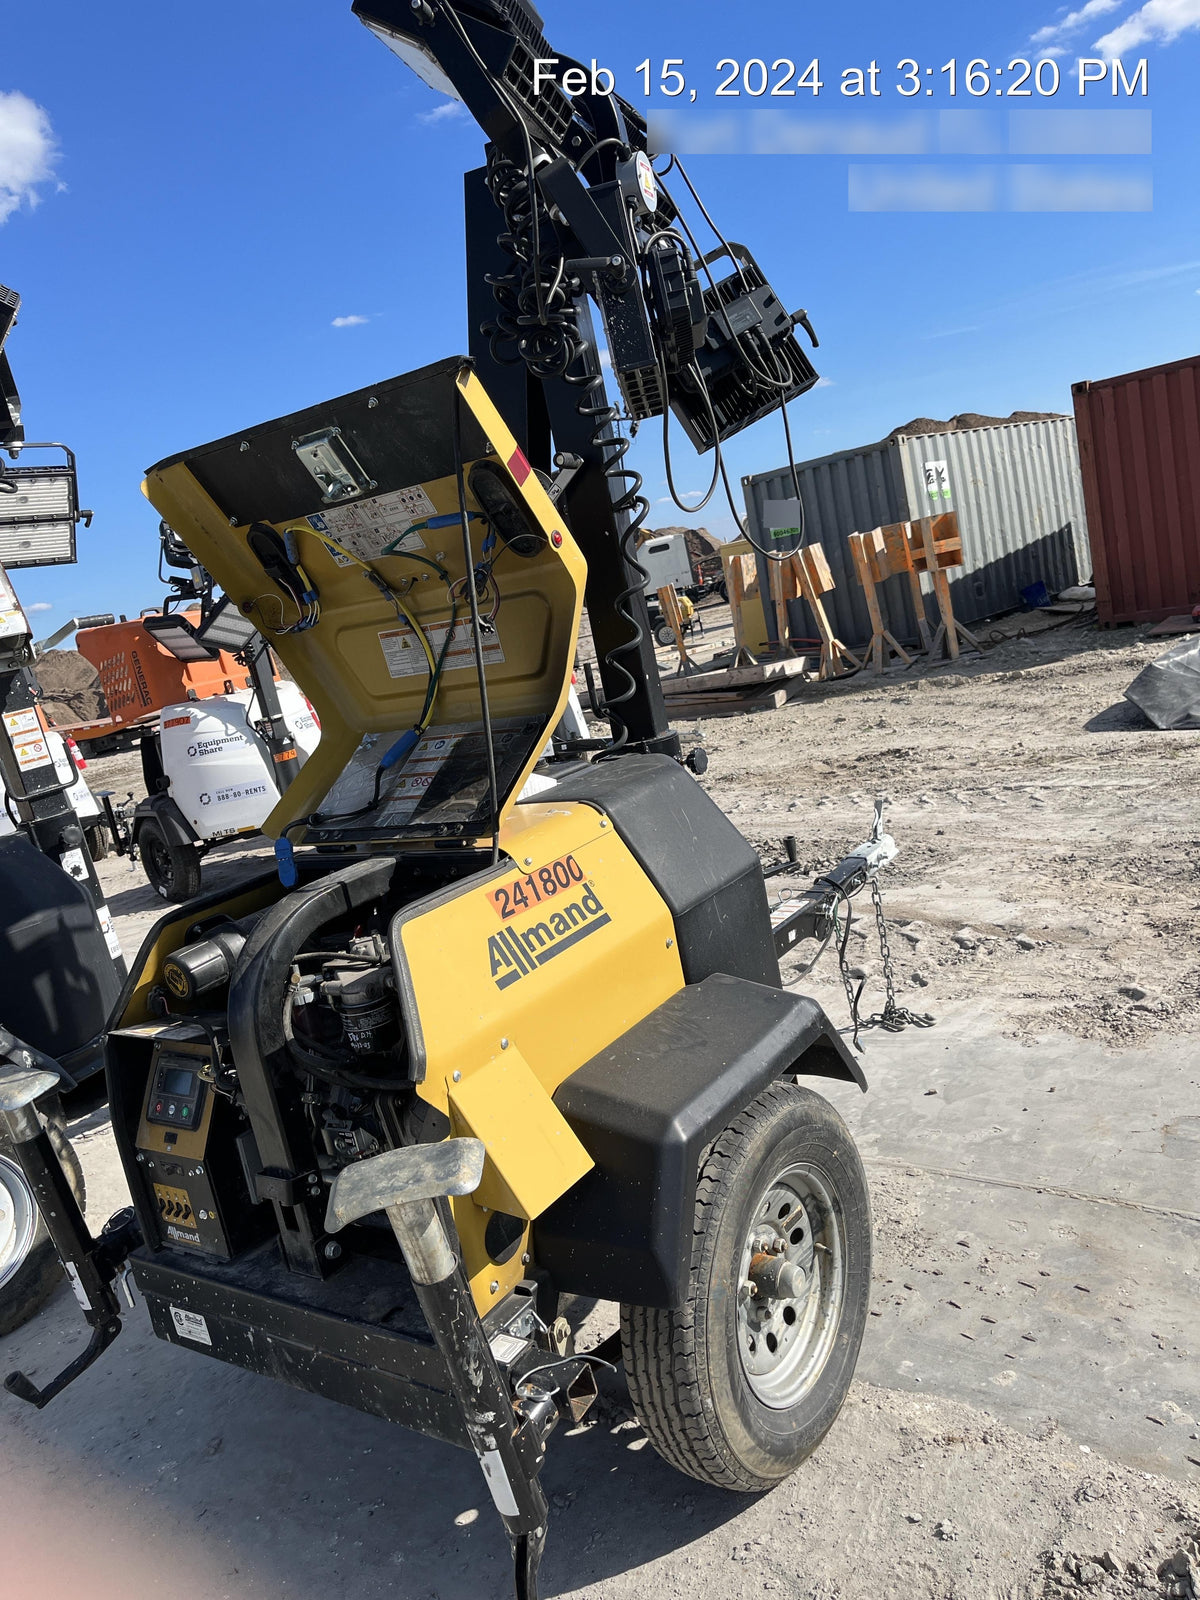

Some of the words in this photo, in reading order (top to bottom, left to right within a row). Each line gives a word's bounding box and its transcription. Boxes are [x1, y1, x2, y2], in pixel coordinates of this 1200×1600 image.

[131, 650, 153, 706] GENERAC
[197, 734, 245, 750] Equipment
[198, 745, 223, 757] Share
[216, 785, 267, 802] 888-80-RENTS
[493, 854, 585, 920] 241800
[487, 881, 605, 978] Allmand
[167, 1225, 201, 1243] Allmand
